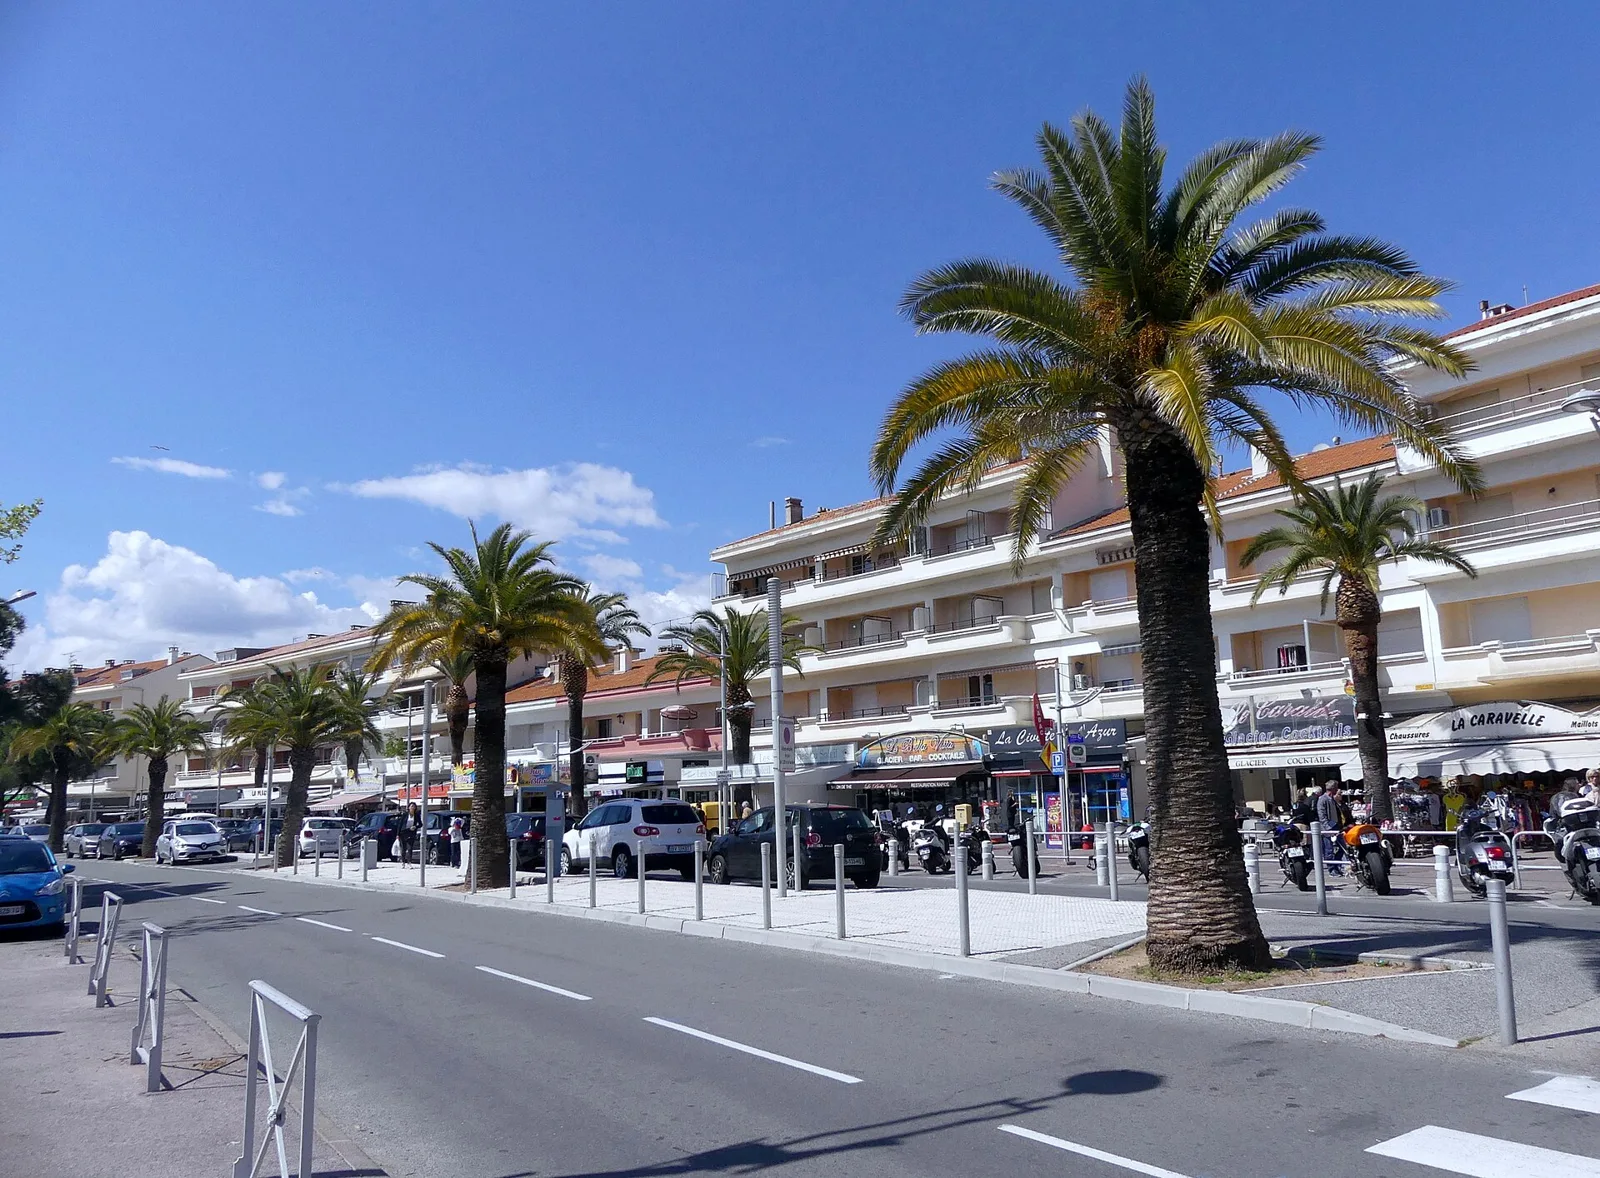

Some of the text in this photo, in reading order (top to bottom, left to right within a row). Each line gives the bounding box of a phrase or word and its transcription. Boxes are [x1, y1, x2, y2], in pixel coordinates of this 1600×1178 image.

[1451, 712, 1546, 732] LA CARAVELLE
[1570, 720, 1599, 729] Maillots
[1281, 721, 1352, 740] Cocktails
[1389, 731, 1431, 740] Chaussures
[994, 730, 1012, 745] La
[1016, 728, 1056, 746] Civte
[928, 751, 965, 761] COCKTAILS
[1055, 755, 1060, 766] P
[1235, 755, 1332, 768] GLACIER COCKTAILS
